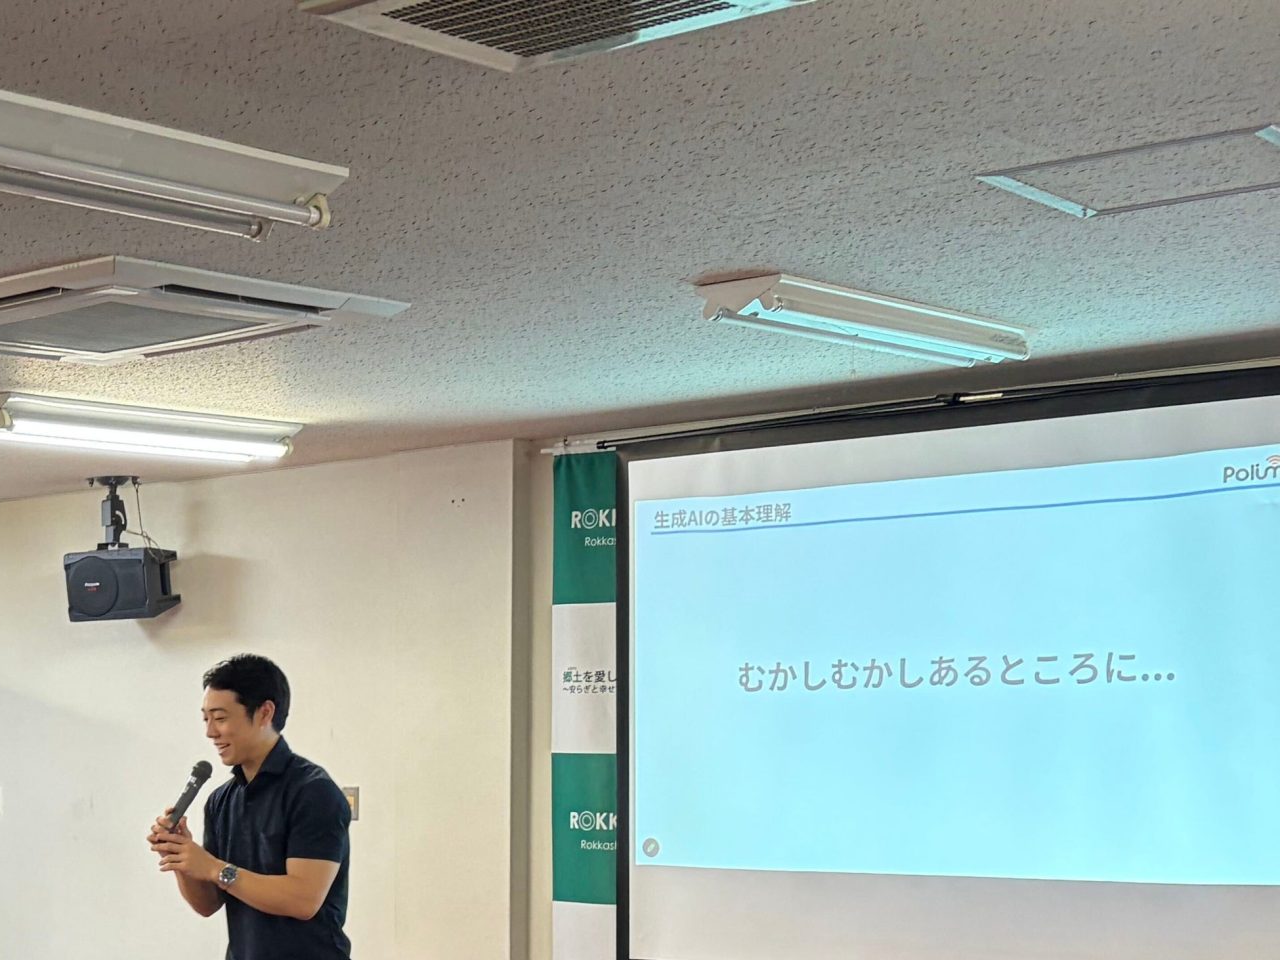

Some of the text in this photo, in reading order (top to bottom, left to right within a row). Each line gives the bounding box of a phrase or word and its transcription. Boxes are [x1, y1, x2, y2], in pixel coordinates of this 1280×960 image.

[654, 503, 792, 529] 生成AIの基本理解
